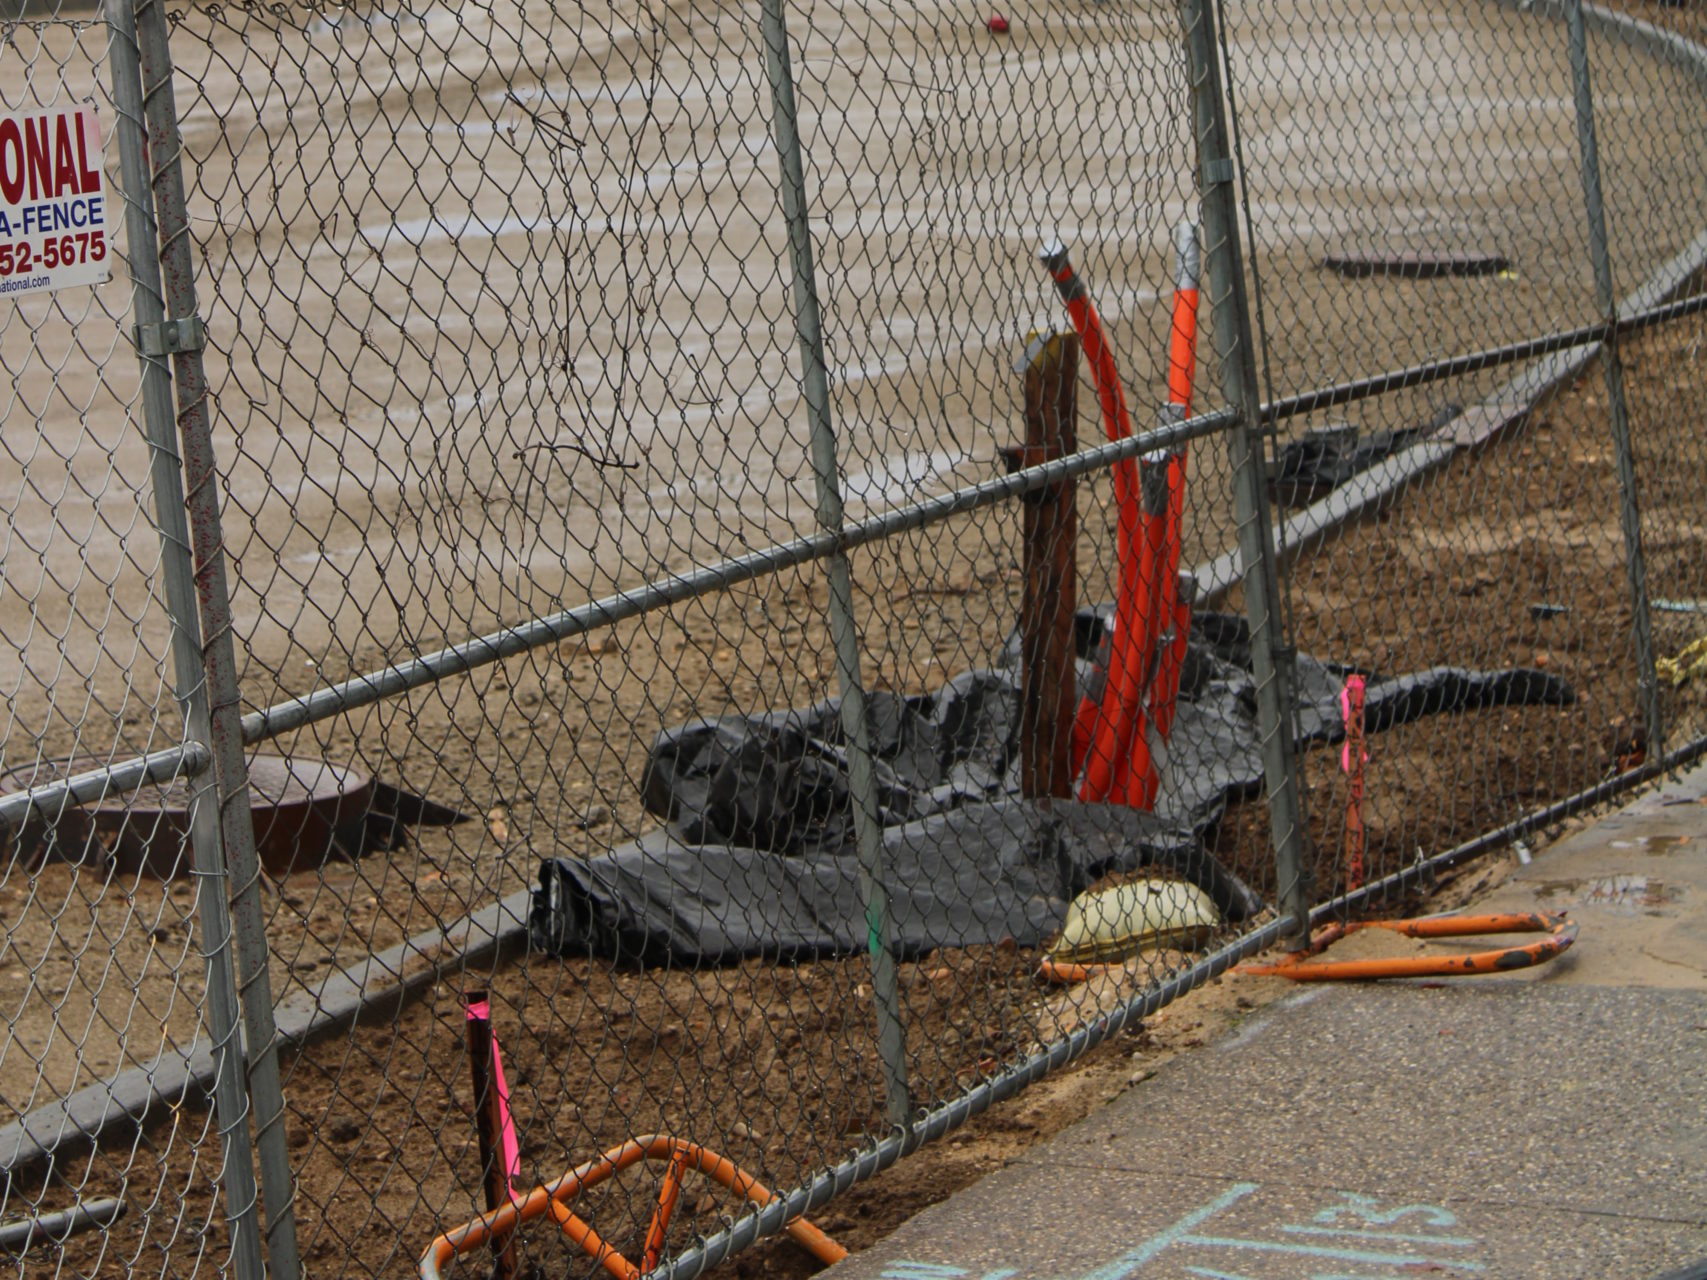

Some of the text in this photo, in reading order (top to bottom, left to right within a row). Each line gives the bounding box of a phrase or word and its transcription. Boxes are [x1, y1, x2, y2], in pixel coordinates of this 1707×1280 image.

[0, 112, 101, 205] ONAL
[0, 230, 107, 276] 52-5675
[0, 276, 50, 293] ational.com
